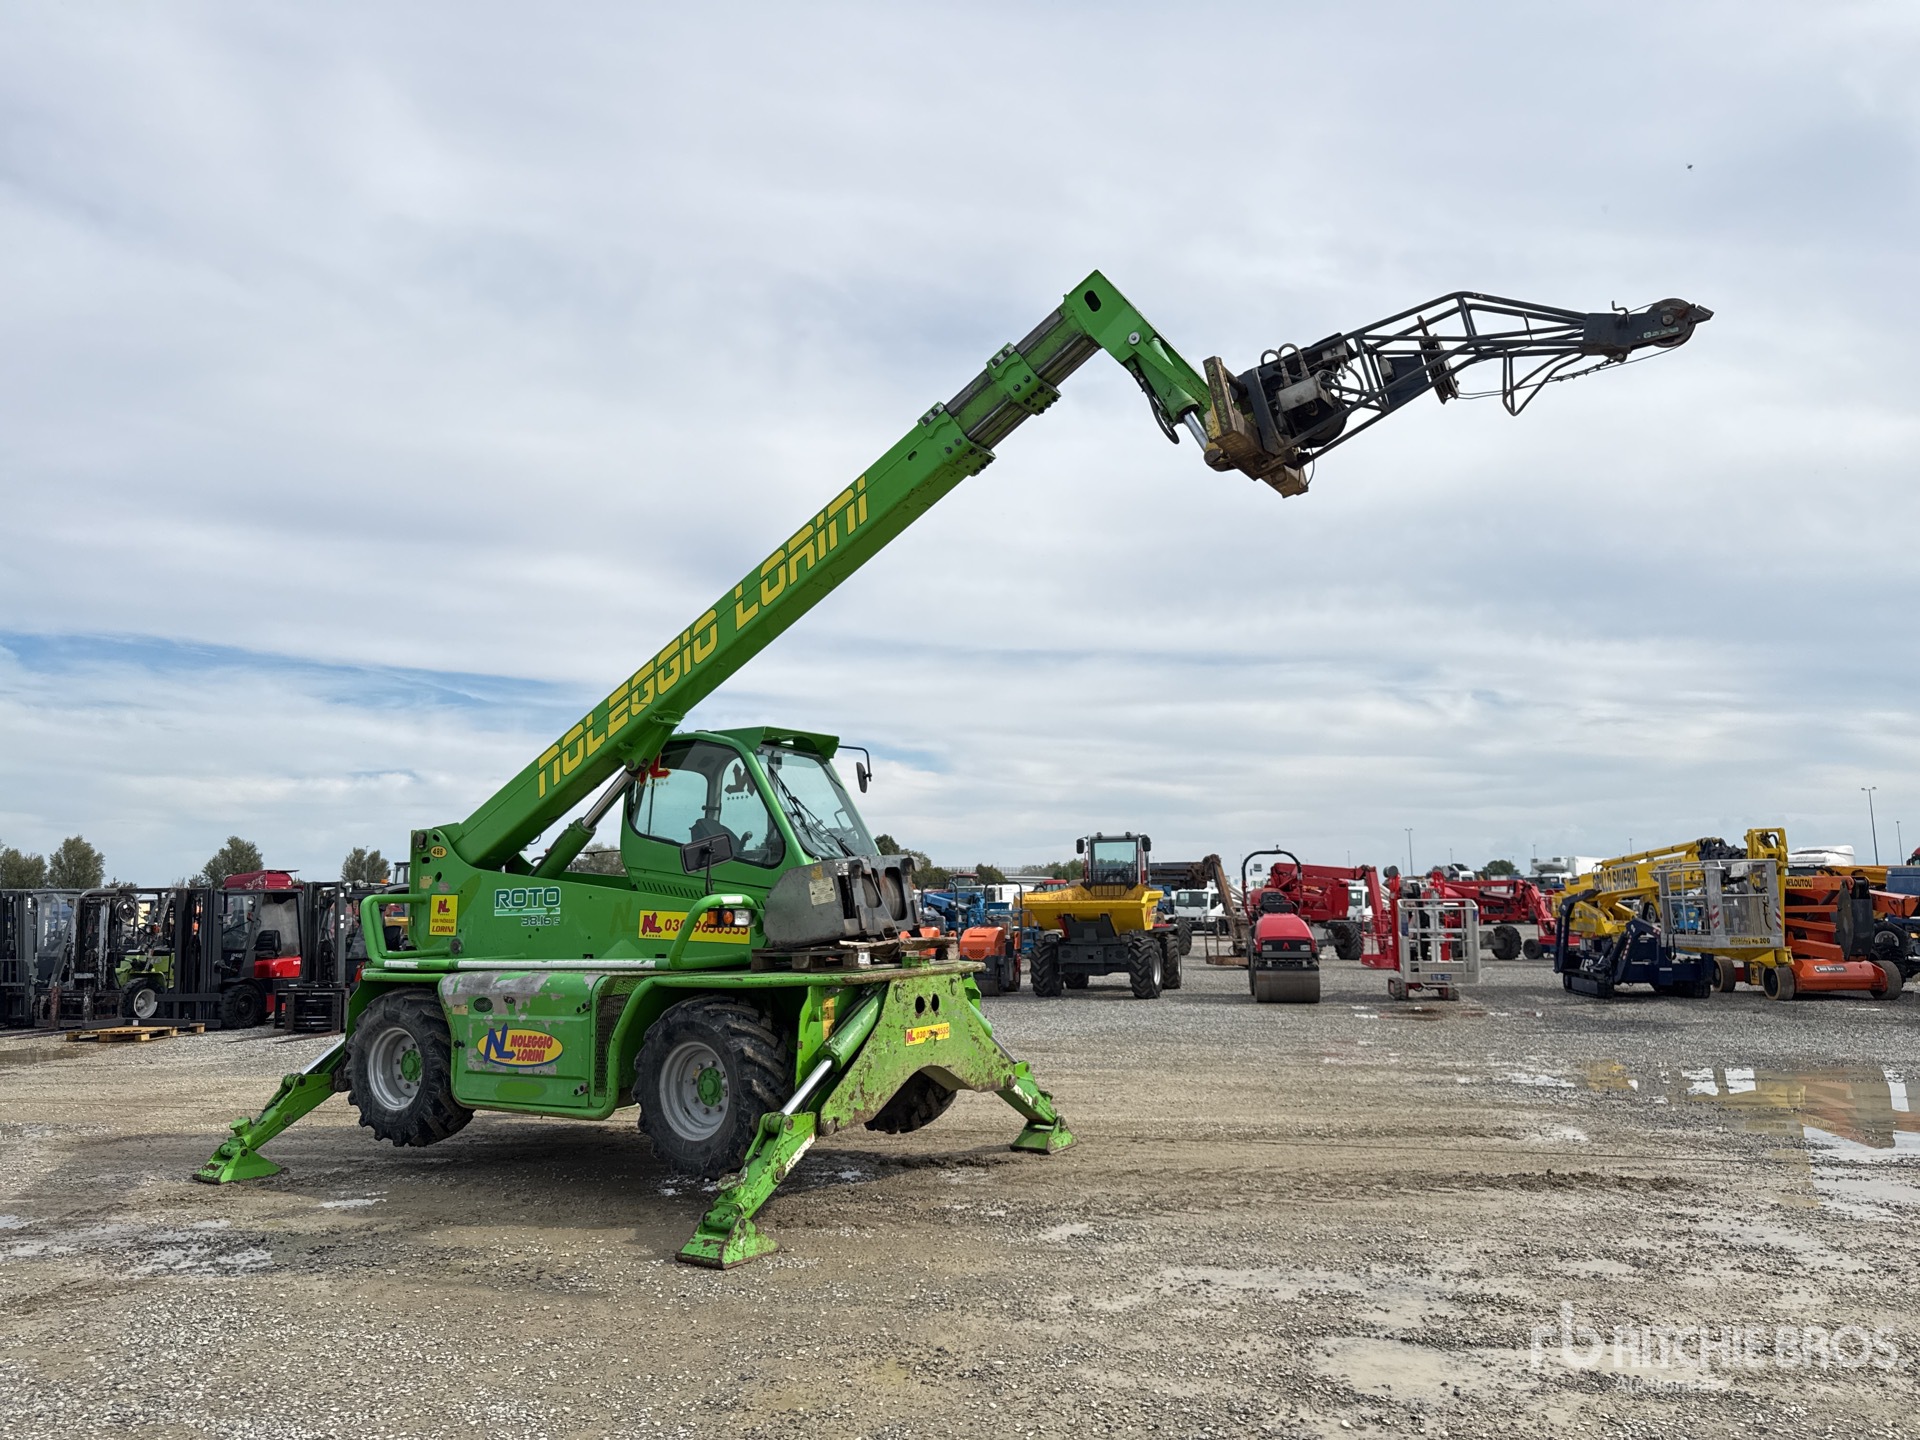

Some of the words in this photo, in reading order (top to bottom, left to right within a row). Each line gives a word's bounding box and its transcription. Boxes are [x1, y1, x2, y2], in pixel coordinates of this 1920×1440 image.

[735, 475, 868, 632] LORINI
[494, 886, 561, 909] ROTO
[510, 1034, 553, 1049] NOLEGGIO
[516, 1048, 546, 1062] LORINI
